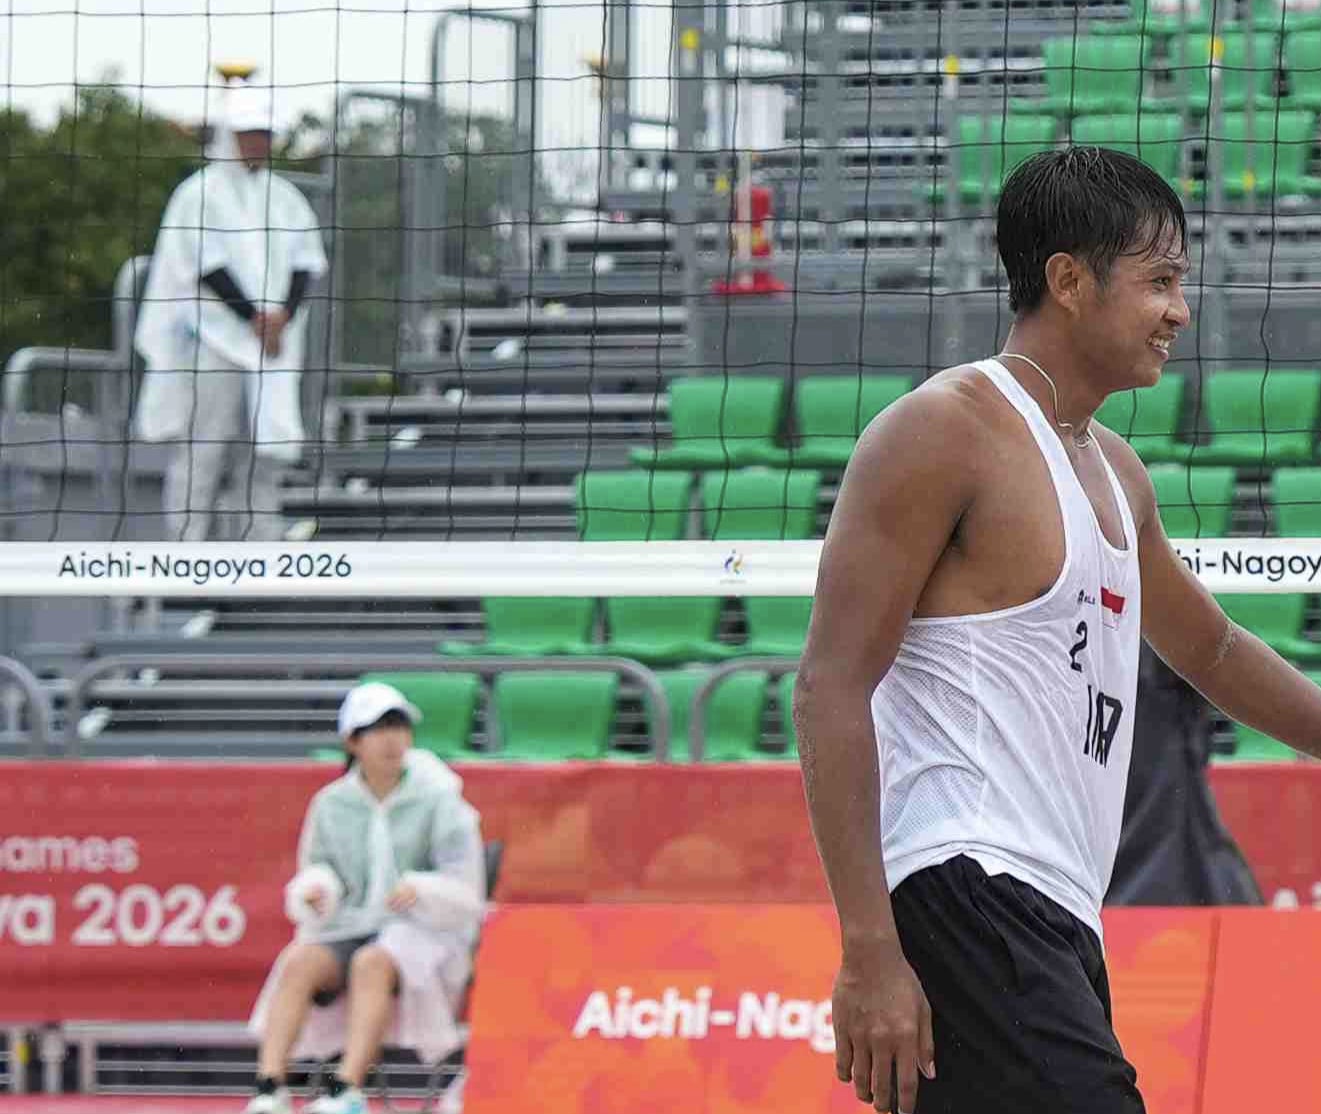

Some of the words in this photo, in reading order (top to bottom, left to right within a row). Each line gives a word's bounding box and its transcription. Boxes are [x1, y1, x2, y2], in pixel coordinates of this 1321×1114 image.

[58, 551, 266, 585] Aichi-Nagoya
[276, 553, 352, 578] 2026
[1069, 620, 1088, 673] 2
[0, 835, 139, 874] ames
[71, 883, 247, 946] 2026
[573, 986, 838, 1053] Aichi-Nag
